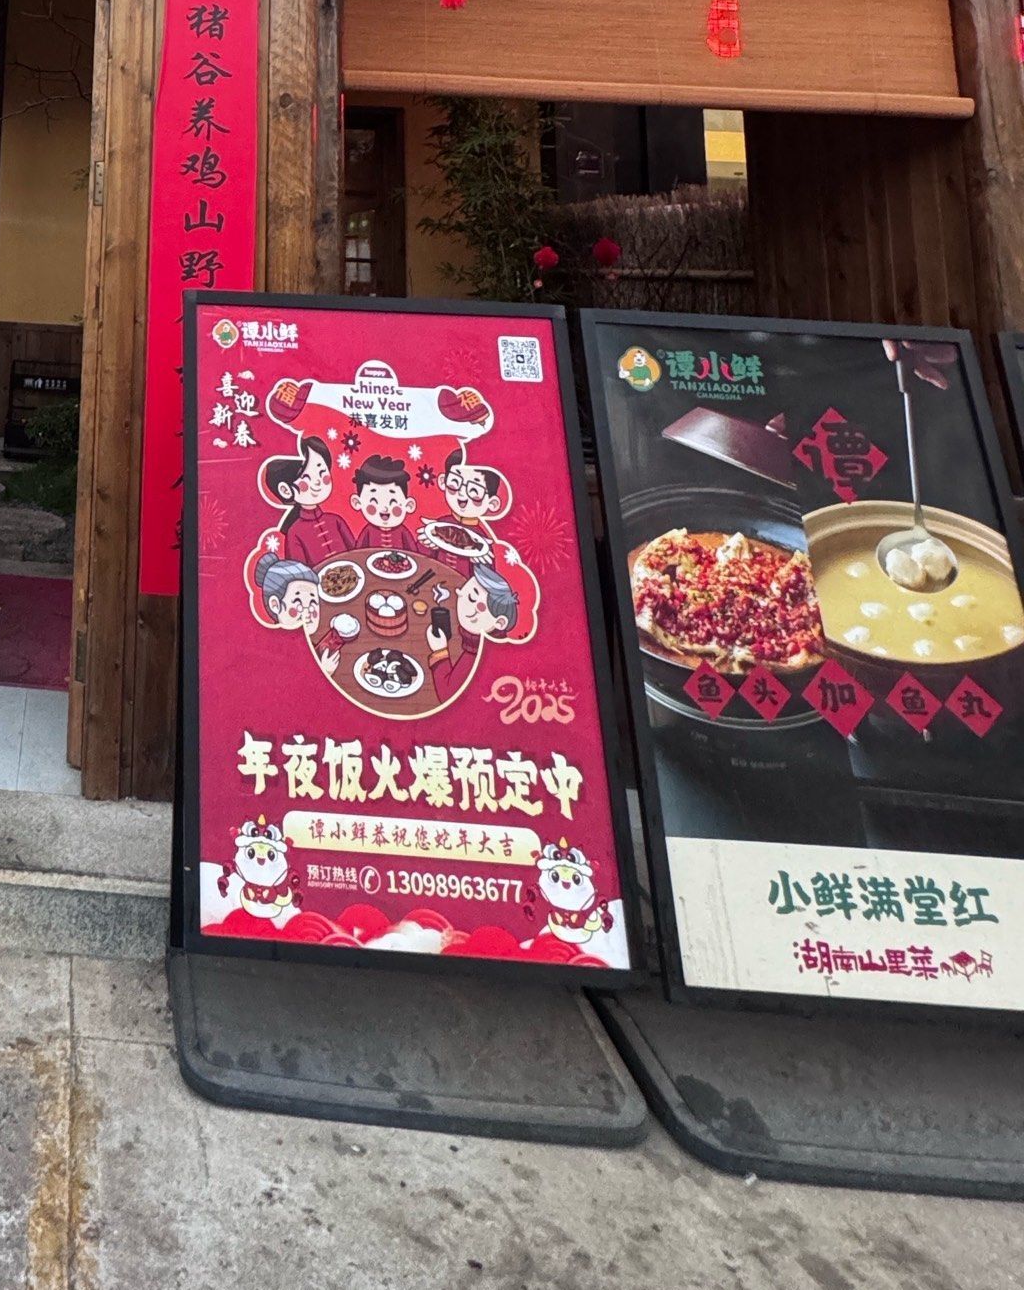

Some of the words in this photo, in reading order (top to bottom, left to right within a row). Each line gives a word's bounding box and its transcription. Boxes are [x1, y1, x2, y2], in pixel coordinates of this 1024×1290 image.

[665, 351, 764, 383] 谭小鲜
[342, 395, 374, 409] New
[378, 397, 412, 412] Year
[670, 380, 766, 396] TANXIAOXIAN
[349, 412, 408, 430] 恭喜发财
[237, 730, 584, 821] 年夜饭火爆预定中
[308, 818, 514, 858] 谭小鲜恭祝您蛇年大吉
[306, 864, 358, 884] 预订热线
[386, 870, 523, 903] 13098963677
[768, 870, 1000, 927] 小鲜满堂红
[792, 938, 939, 980] 湖南山里菜
